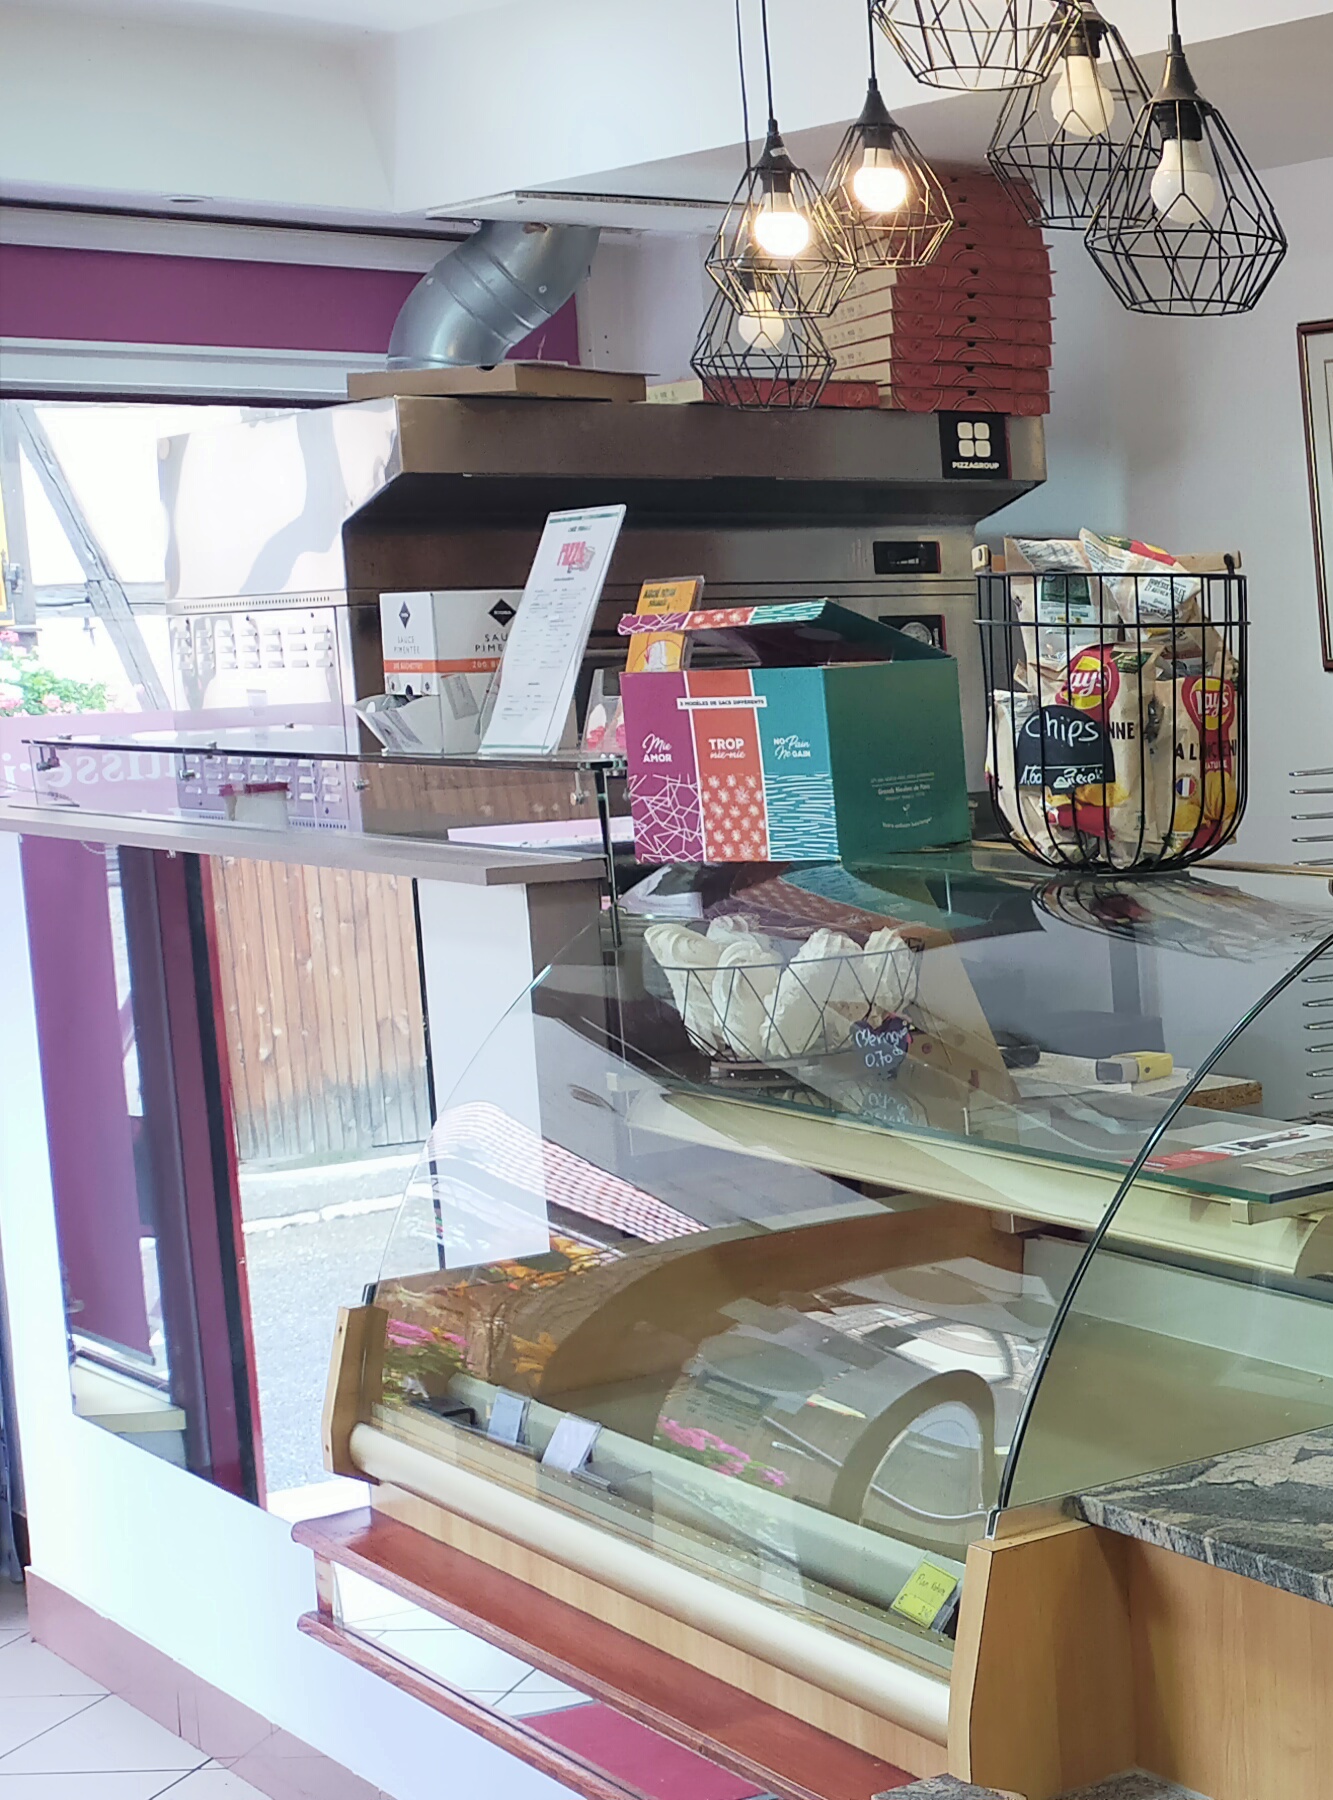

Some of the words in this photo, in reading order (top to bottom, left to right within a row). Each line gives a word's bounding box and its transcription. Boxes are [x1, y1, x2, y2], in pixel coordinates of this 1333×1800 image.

[952, 461, 1000, 470] PIZZAGROUP
[484, 633, 509, 643] SAU
[474, 644, 503, 653] PIME
[1025, 711, 1100, 747] Chips
[641, 733, 673, 752] Mie
[708, 737, 745, 751] TROP
[643, 752, 673, 763] AMOR
